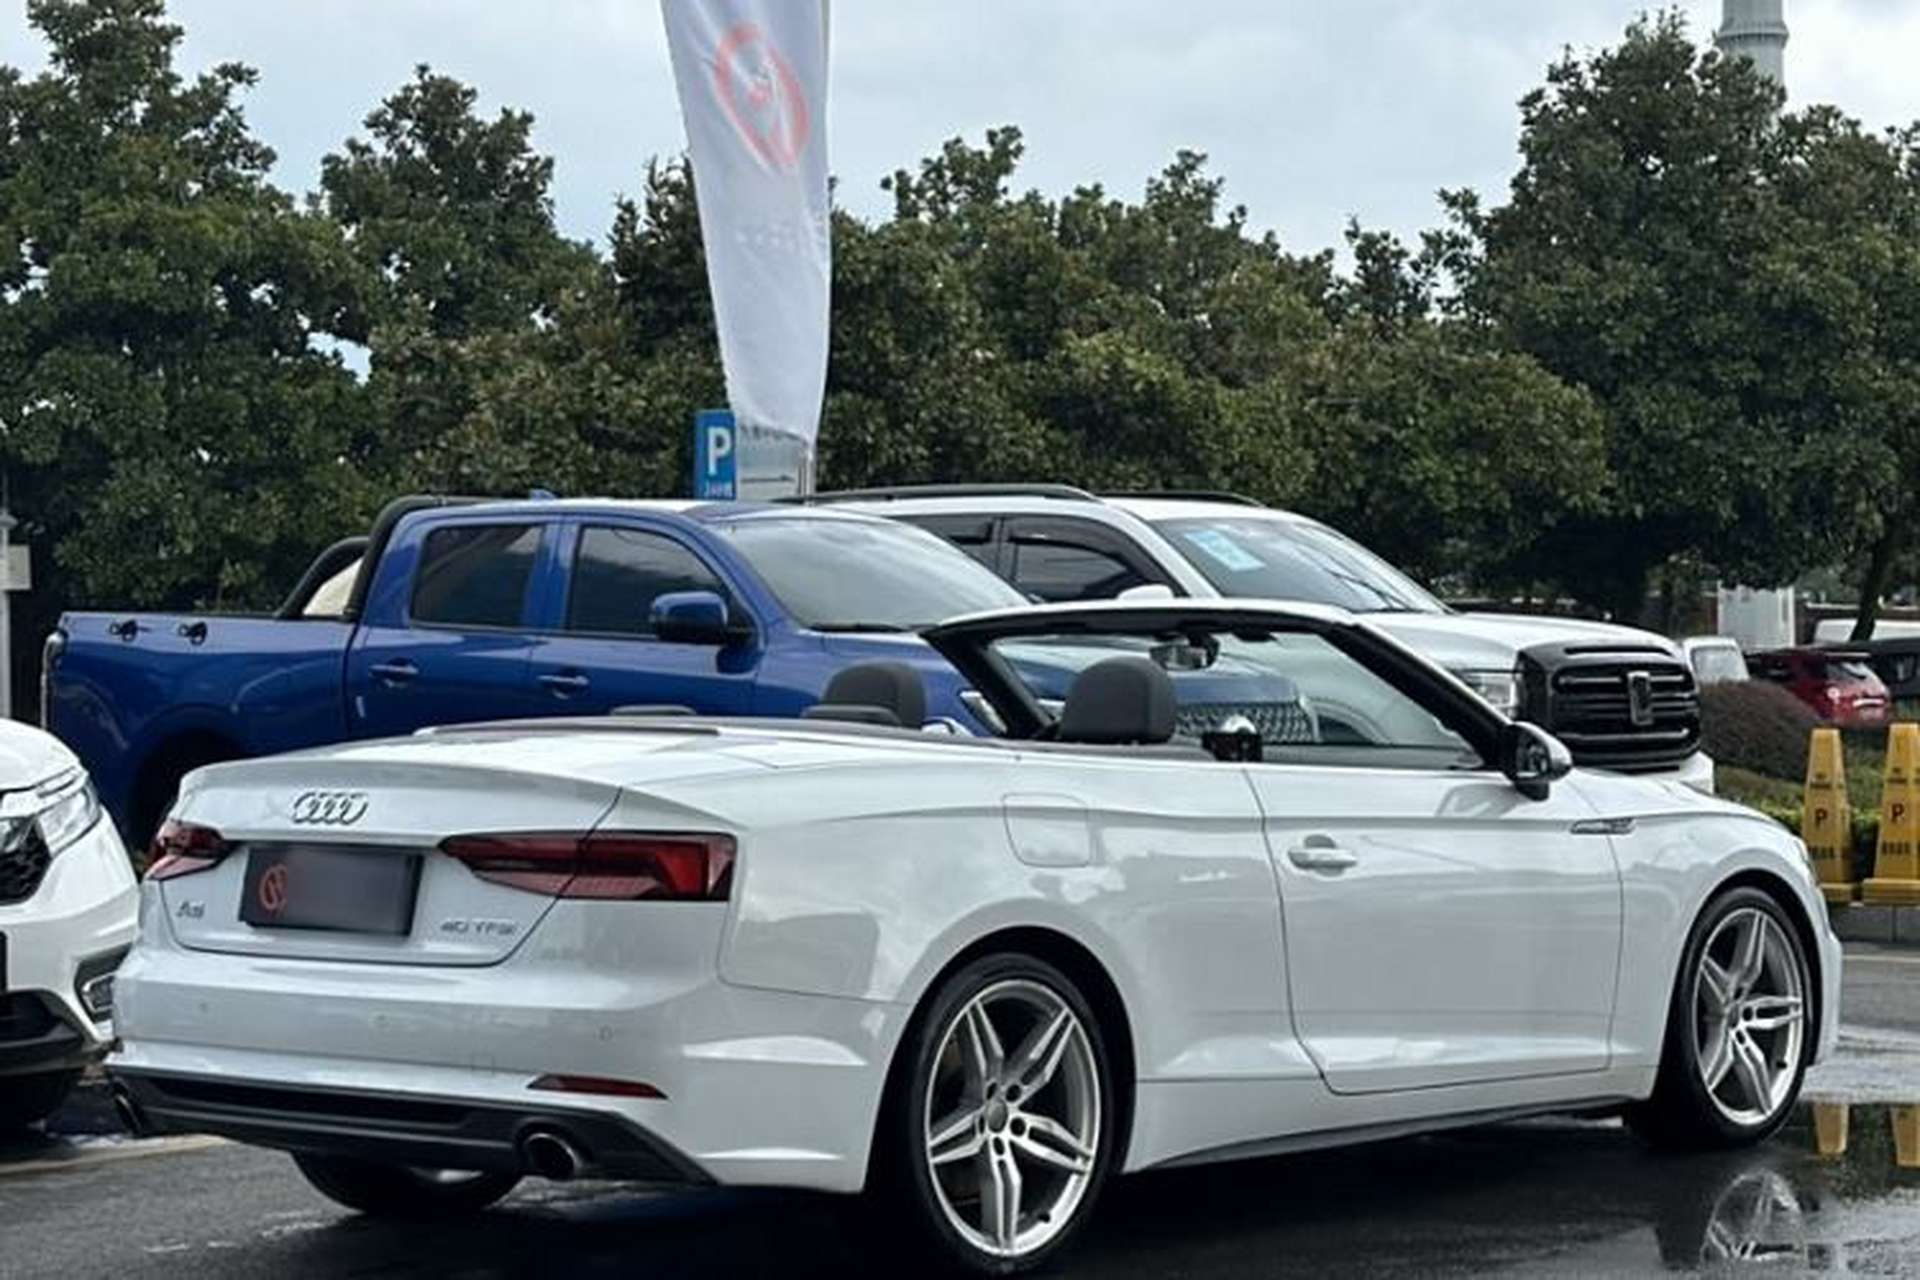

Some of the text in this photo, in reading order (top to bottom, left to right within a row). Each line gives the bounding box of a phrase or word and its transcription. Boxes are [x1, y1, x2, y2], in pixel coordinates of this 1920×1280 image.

[707, 427, 732, 475] P
[1815, 808, 1828, 829] P
[1891, 803, 1904, 824] P
